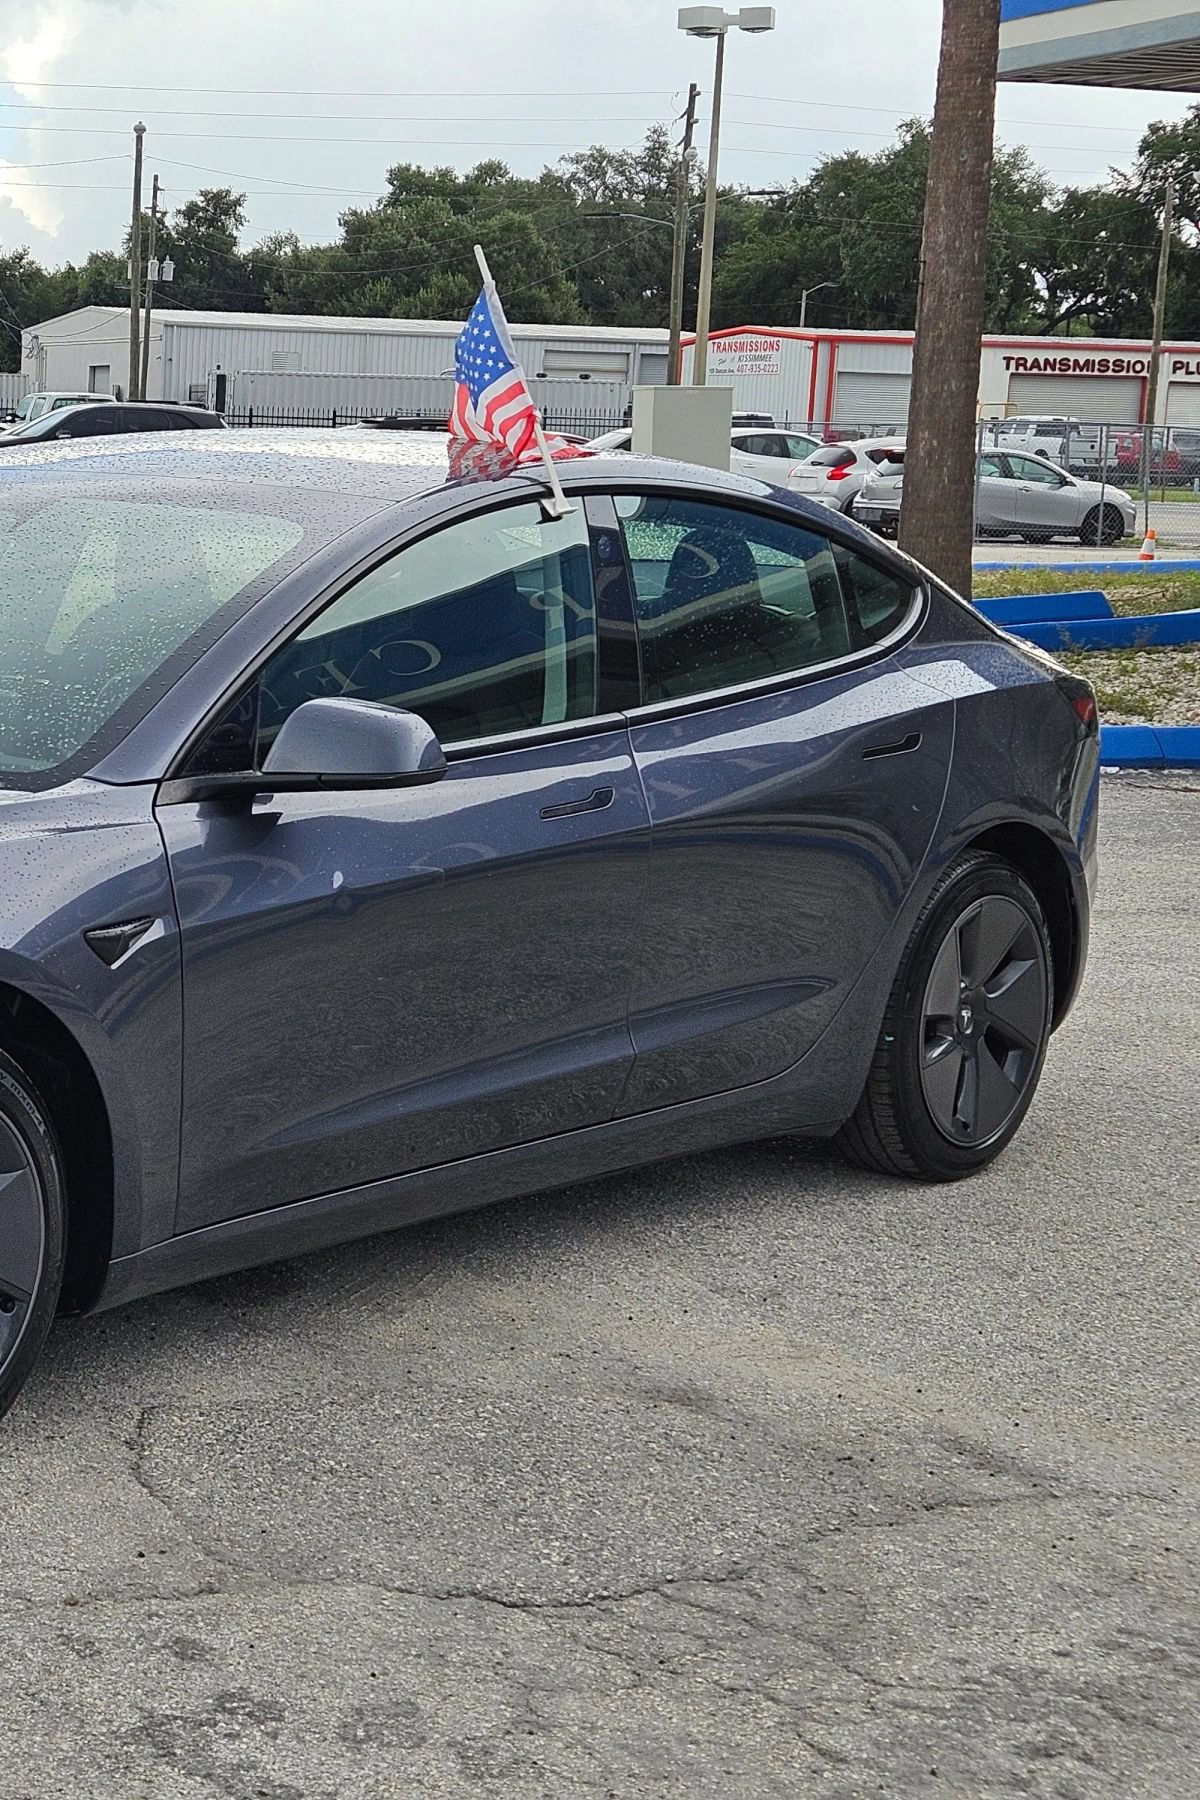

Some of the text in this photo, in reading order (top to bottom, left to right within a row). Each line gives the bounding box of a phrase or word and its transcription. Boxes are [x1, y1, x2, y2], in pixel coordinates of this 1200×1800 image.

[711, 340, 781, 354] TRANSMISSIONS
[737, 353, 774, 363] KISSIMMEE
[736, 363, 779, 374] 407-935-0223
[1002, 356, 1200, 375] TRANSMISSIO PL
